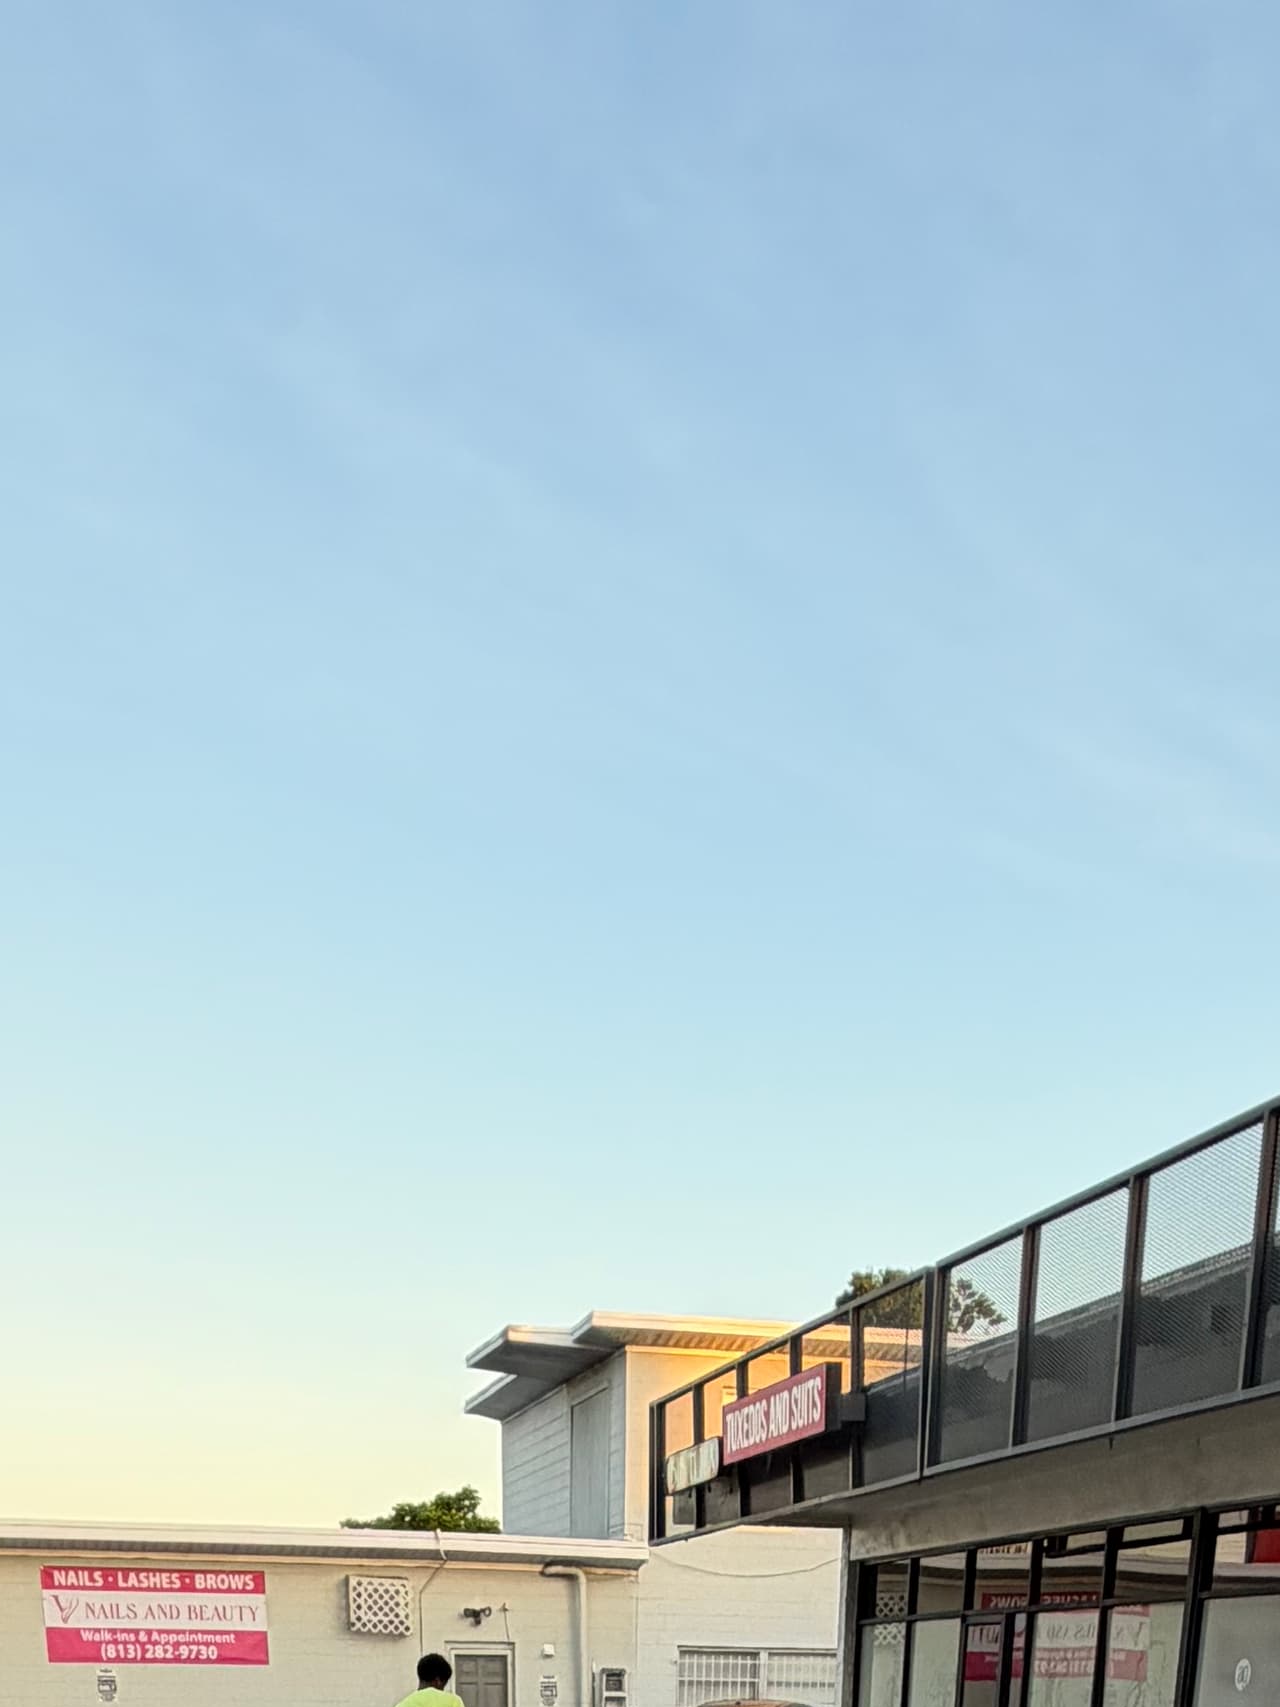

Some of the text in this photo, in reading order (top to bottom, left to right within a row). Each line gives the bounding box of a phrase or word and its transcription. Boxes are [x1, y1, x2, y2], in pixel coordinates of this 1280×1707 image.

[725, 1378, 822, 1453] TUXEDOS AND SUITS
[53, 1570, 255, 1591] NAILS LASHES BROWS
[85, 1602, 138, 1620] NAILS
[141, 1603, 182, 1621] AND
[187, 1604, 260, 1623] BEAUTY
[80, 1629, 236, 1647] Walk-ins & Appointment
[100, 1643, 218, 1661] (813) 282-9730
